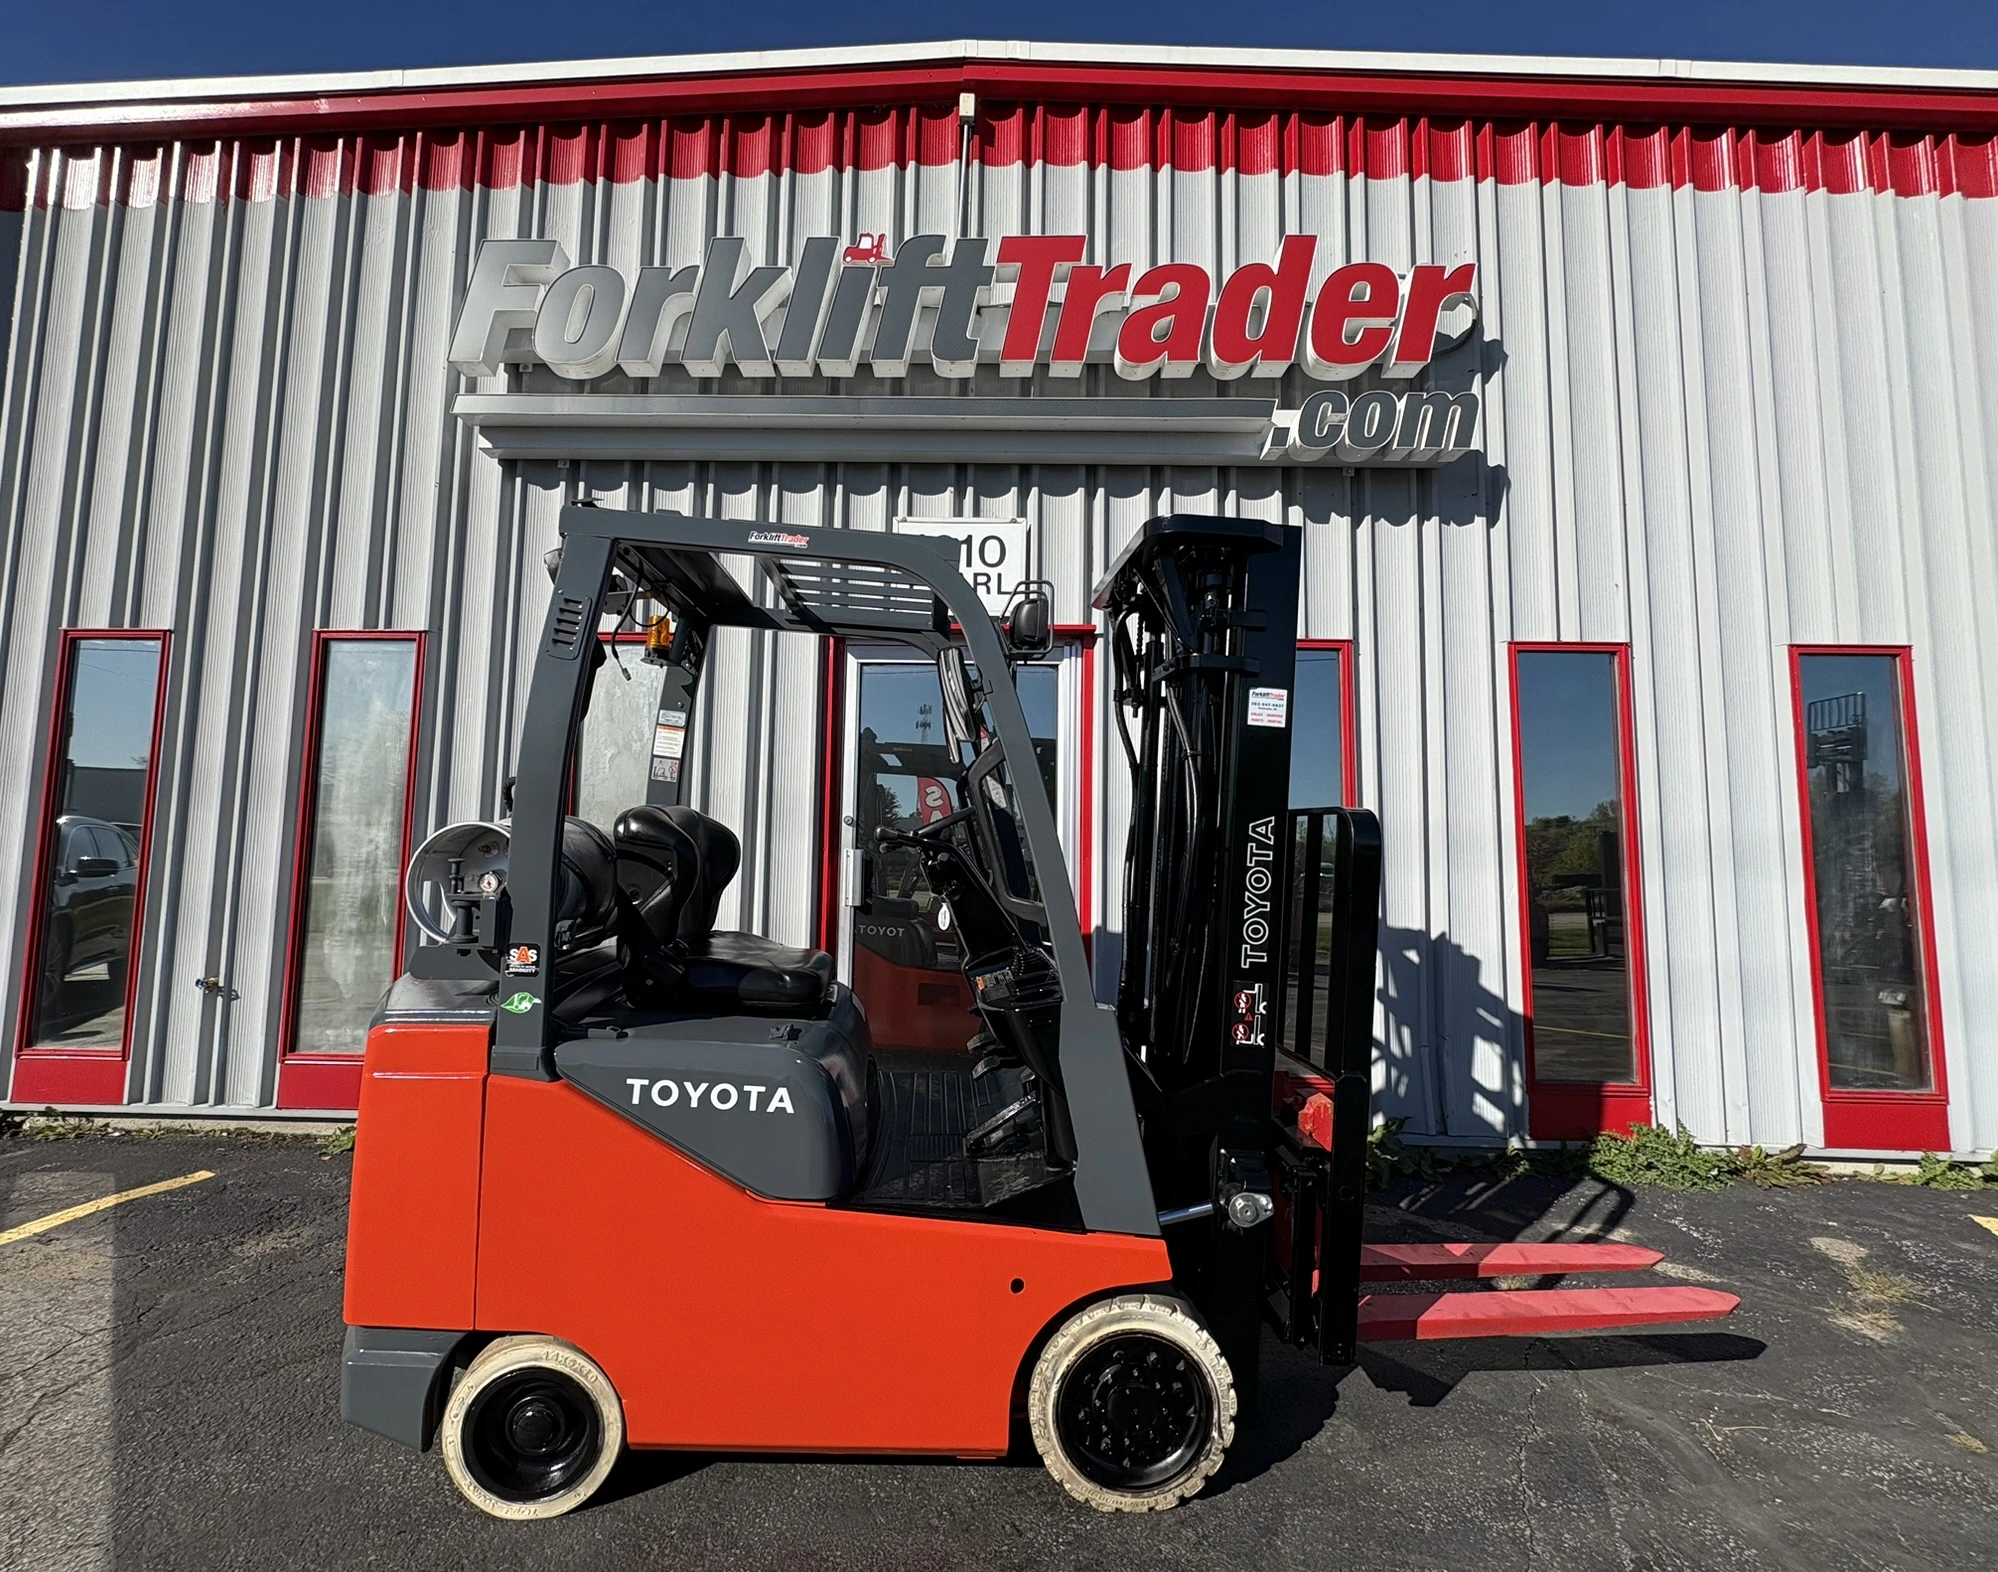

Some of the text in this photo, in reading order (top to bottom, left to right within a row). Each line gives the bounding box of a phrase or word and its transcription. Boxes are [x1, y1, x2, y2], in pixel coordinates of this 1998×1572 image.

[750, 531, 809, 543] ForkliftTrader
[1241, 816, 1275, 968] TOYOTA
[509, 946, 538, 963] SAS
[626, 1078, 795, 1114] TOYOTA
